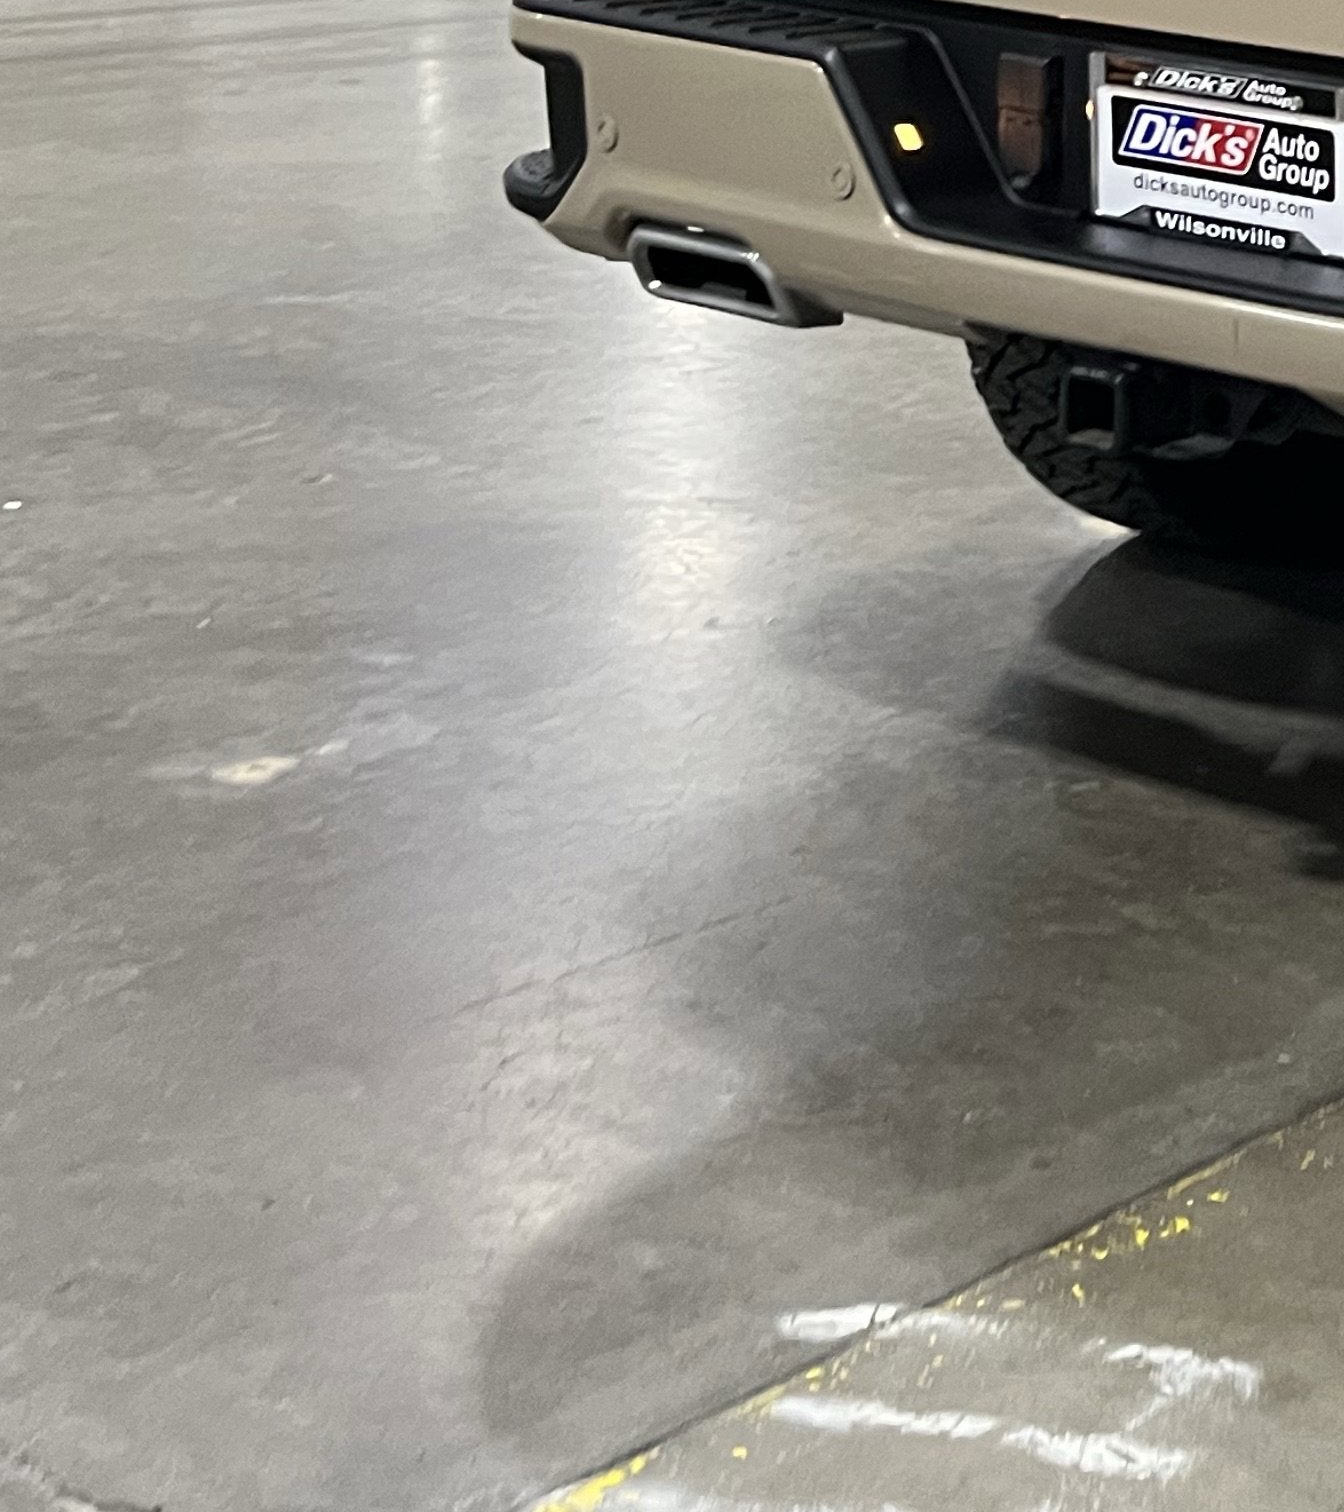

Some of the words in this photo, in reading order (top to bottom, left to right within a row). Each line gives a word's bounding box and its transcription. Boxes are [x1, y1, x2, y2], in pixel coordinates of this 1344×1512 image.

[1155, 69, 1239, 97] Dick's
[1249, 80, 1287, 96] Auto
[1128, 112, 1250, 168] Dick's
[1262, 128, 1319, 162] Auto
[1259, 154, 1330, 195] Group
[1133, 173, 1315, 220] dicksautogroup.com
[1154, 210, 1287, 250] Wilsonville
